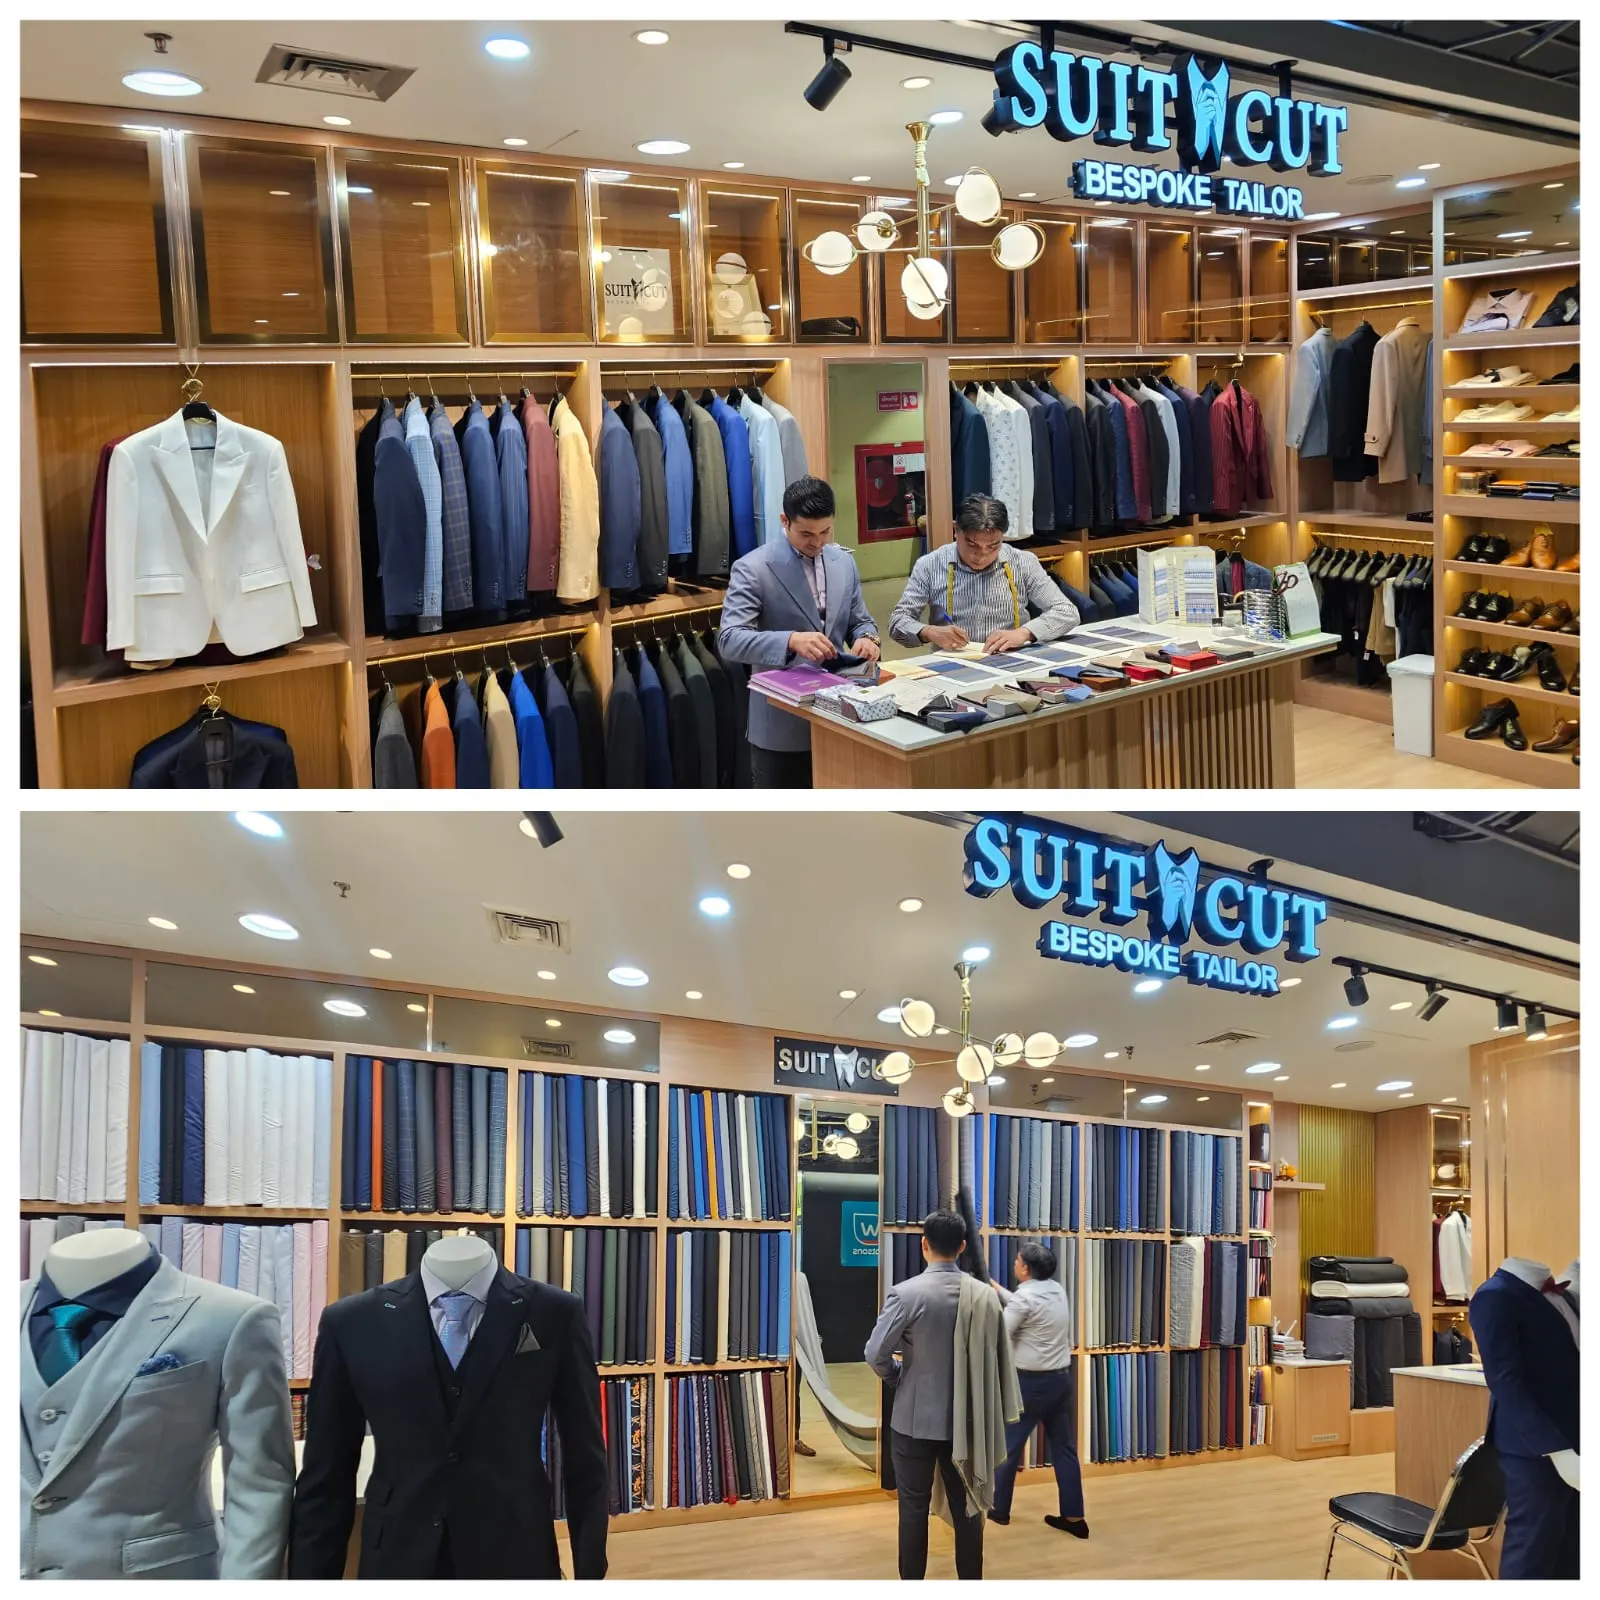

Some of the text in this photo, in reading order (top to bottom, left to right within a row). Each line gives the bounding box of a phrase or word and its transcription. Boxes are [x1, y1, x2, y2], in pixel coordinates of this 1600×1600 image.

[1011, 41, 1347, 174] SUIT CUT
[1085, 161, 1304, 218] BESPOKE TAILOR
[605, 283, 631, 297] SUIT
[974, 818, 1327, 957] SUIT CUT
[1050, 922, 1279, 992] BESPOKE TAILOR
[778, 1048, 884, 1081] SUIT CU
